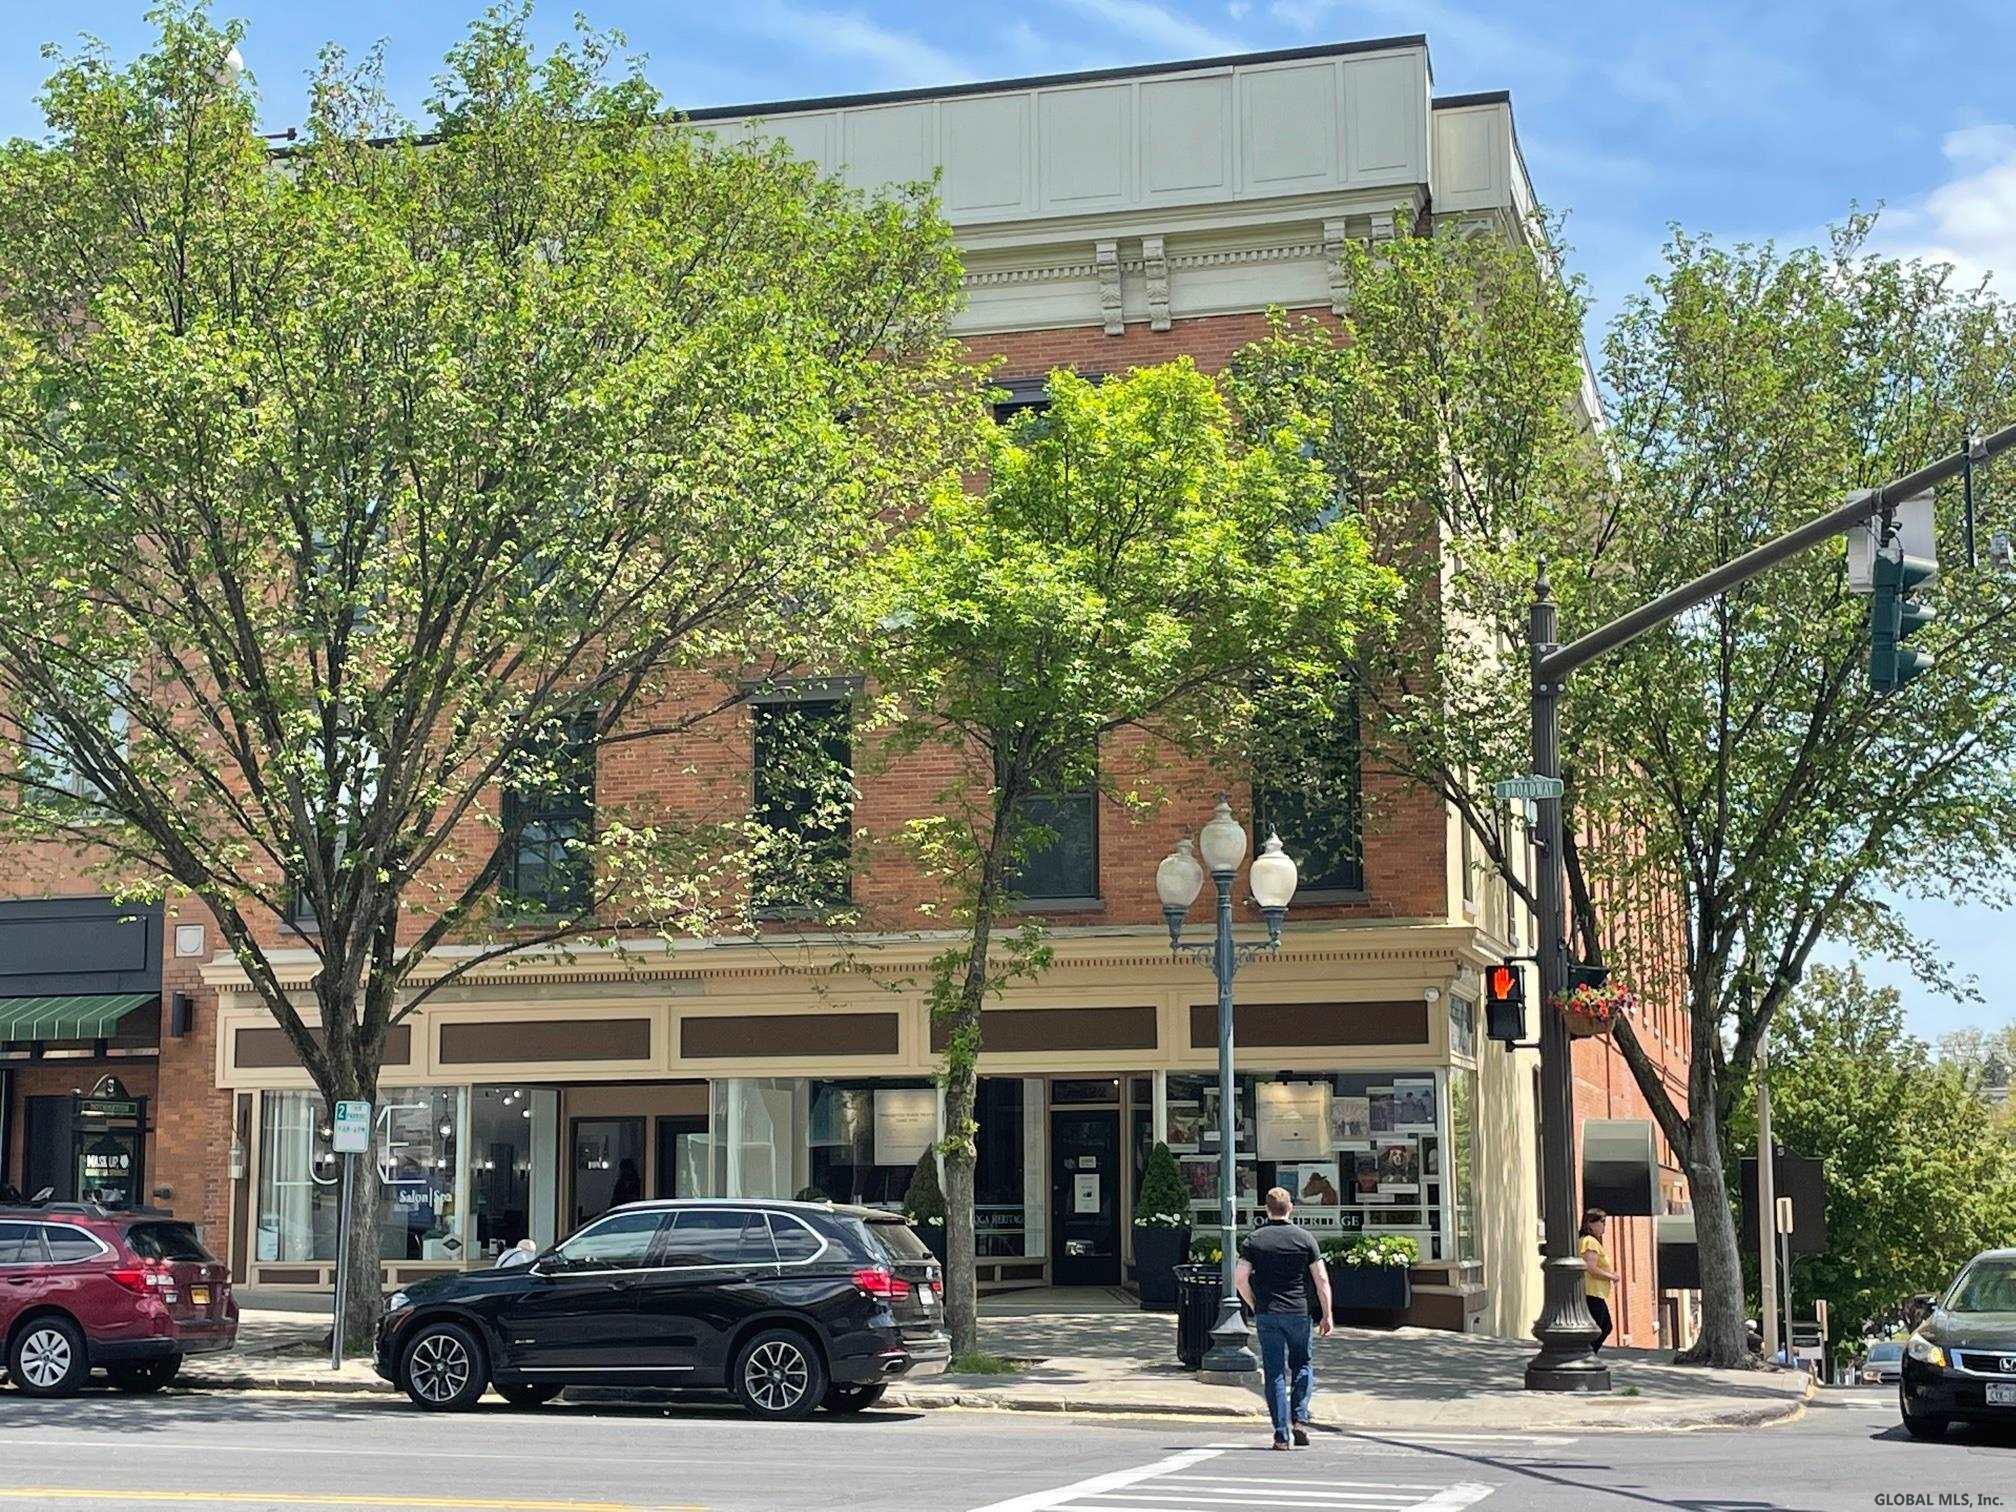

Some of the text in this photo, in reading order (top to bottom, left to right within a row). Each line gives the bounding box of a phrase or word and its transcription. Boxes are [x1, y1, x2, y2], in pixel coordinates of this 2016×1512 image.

[1505, 782, 1553, 797] BROADWAY
[338, 1104, 346, 1119] 2
[273, 1105, 430, 1186] LUE
